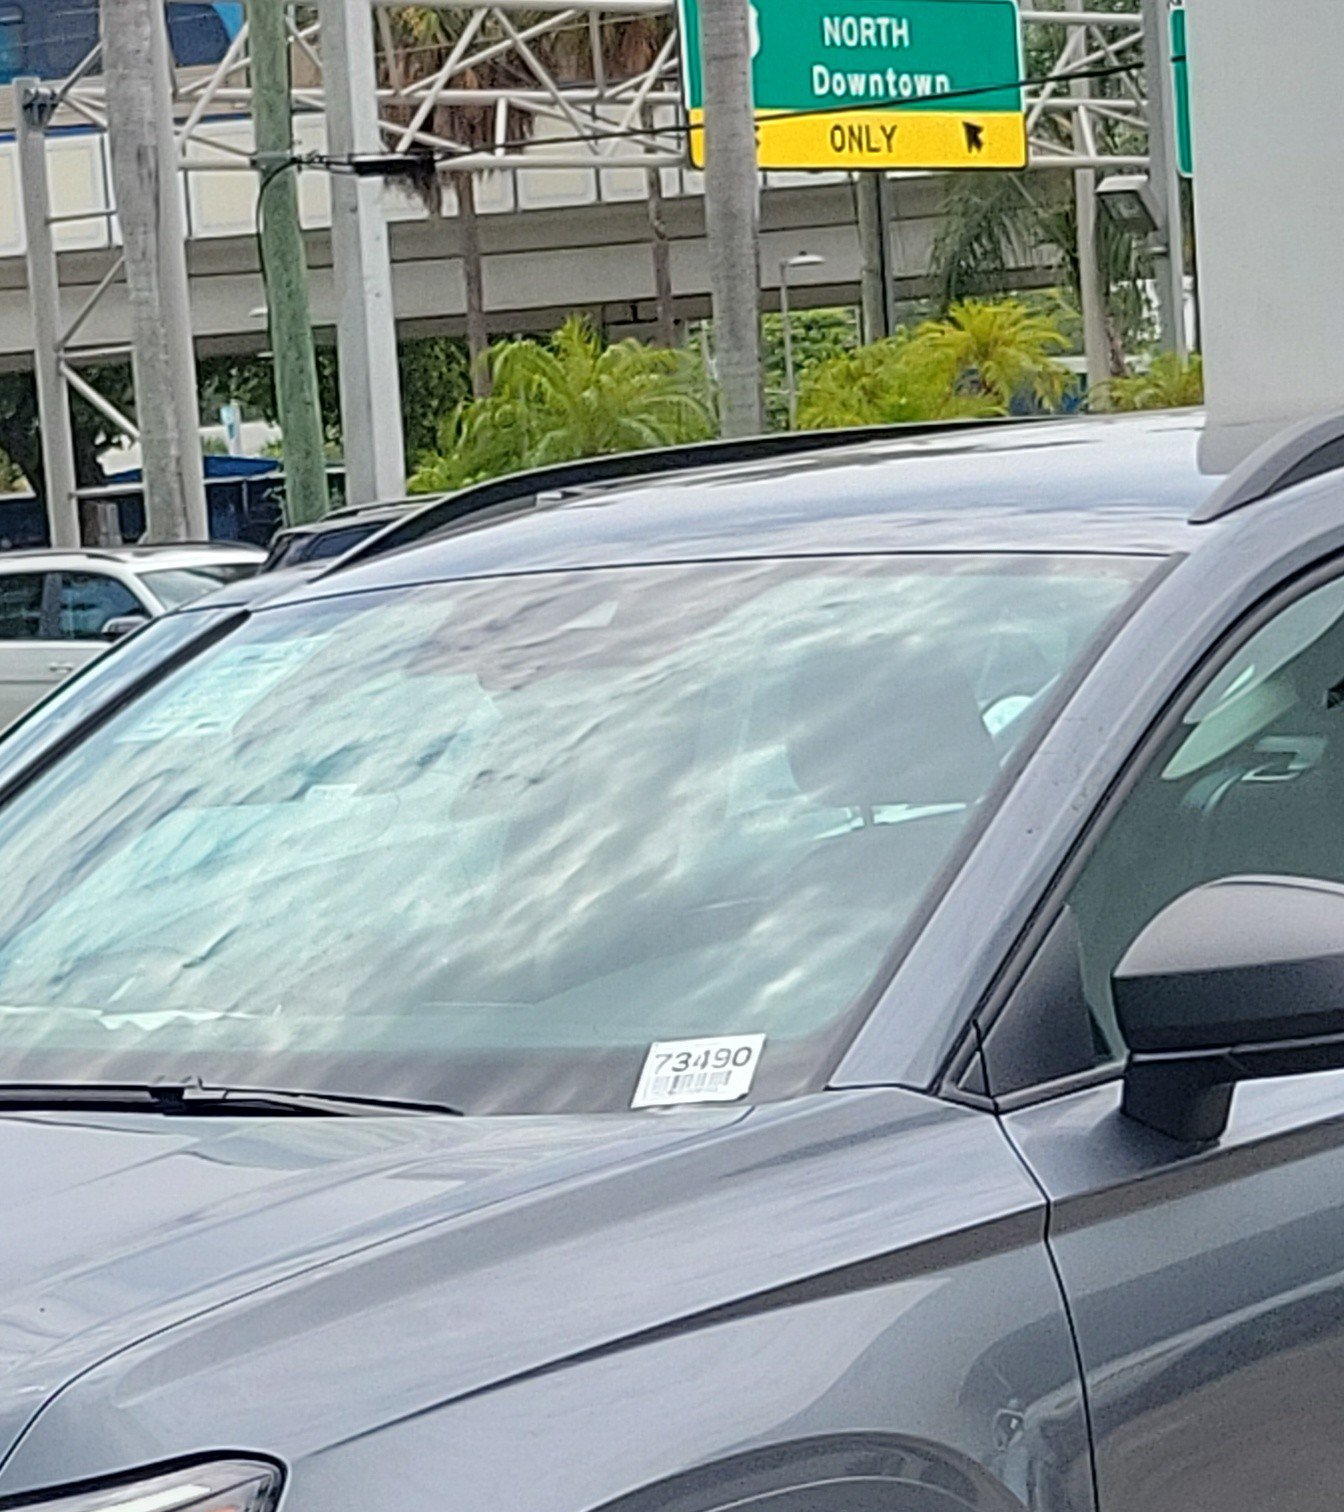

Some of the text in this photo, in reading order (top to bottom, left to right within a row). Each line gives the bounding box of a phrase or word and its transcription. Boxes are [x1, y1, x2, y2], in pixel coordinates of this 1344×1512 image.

[823, 16, 909, 47] NORTH
[812, 64, 951, 98] Downtown
[830, 124, 897, 153] ONLY
[655, 1046, 753, 1075] 73490
